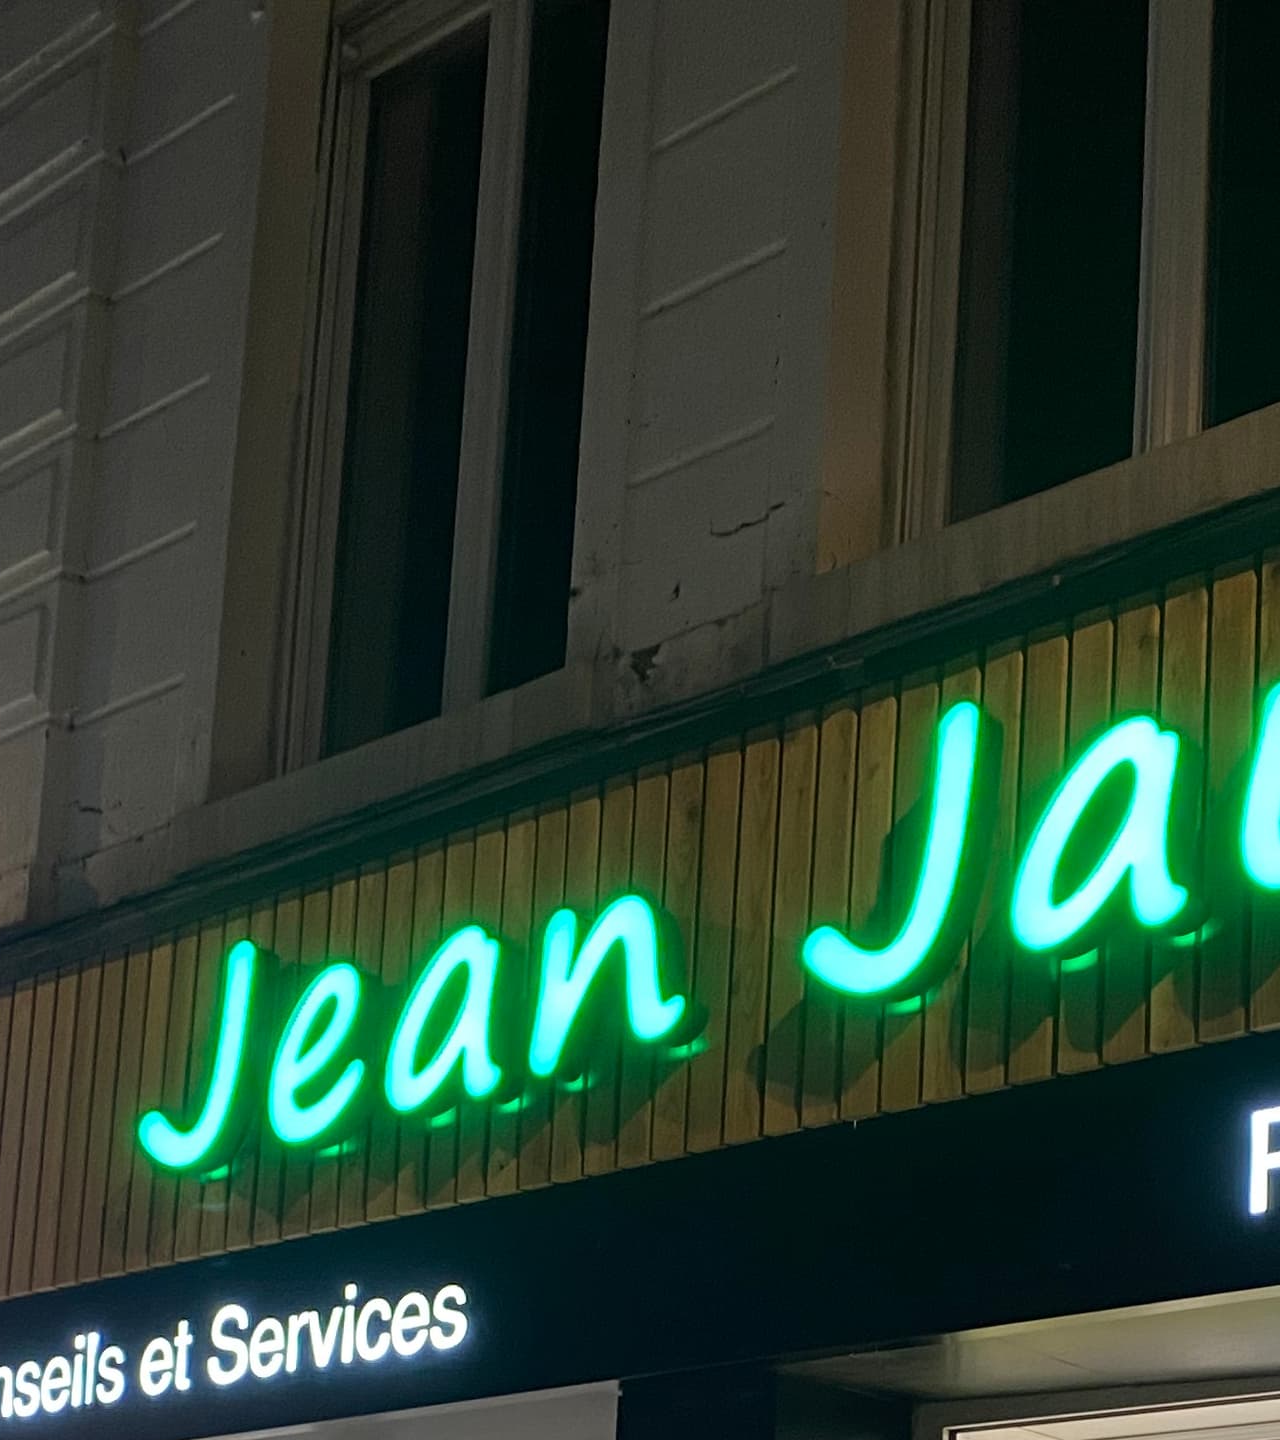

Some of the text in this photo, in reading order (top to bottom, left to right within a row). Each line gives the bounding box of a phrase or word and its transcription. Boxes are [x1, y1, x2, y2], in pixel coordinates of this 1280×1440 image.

[139, 894, 686, 1168] Jean
[139, 1319, 194, 1397] et
[207, 1282, 469, 1386] Services
